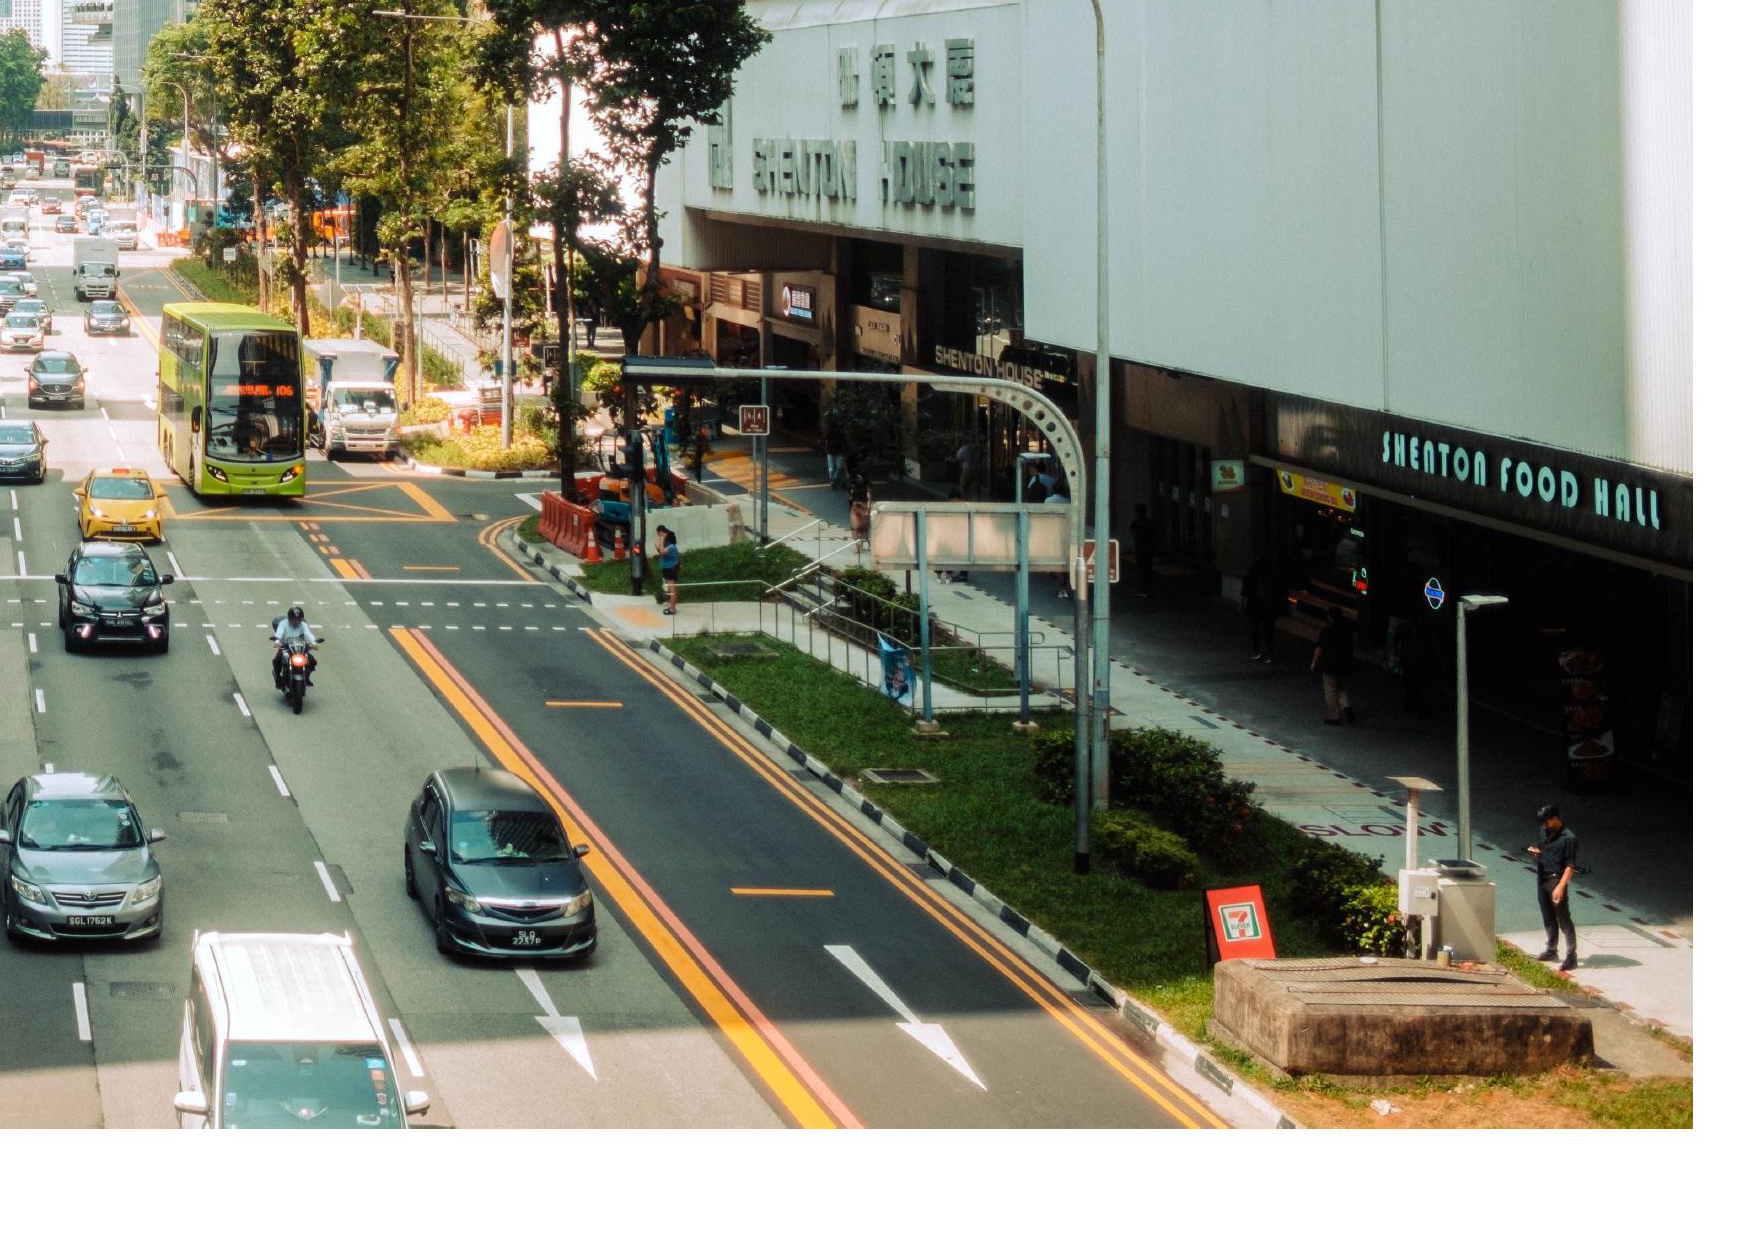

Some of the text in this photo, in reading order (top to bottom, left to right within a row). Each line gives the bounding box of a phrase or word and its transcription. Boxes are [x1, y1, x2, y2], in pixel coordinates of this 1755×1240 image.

[753, 138, 975, 210] SHENTON HOUSE
[935, 345, 994, 378] SHENTON
[997, 360, 1043, 390] HOUSE
[1382, 431, 1660, 530] SHENTON FOOD HALL
[1296, 823, 1449, 837] SLOW
